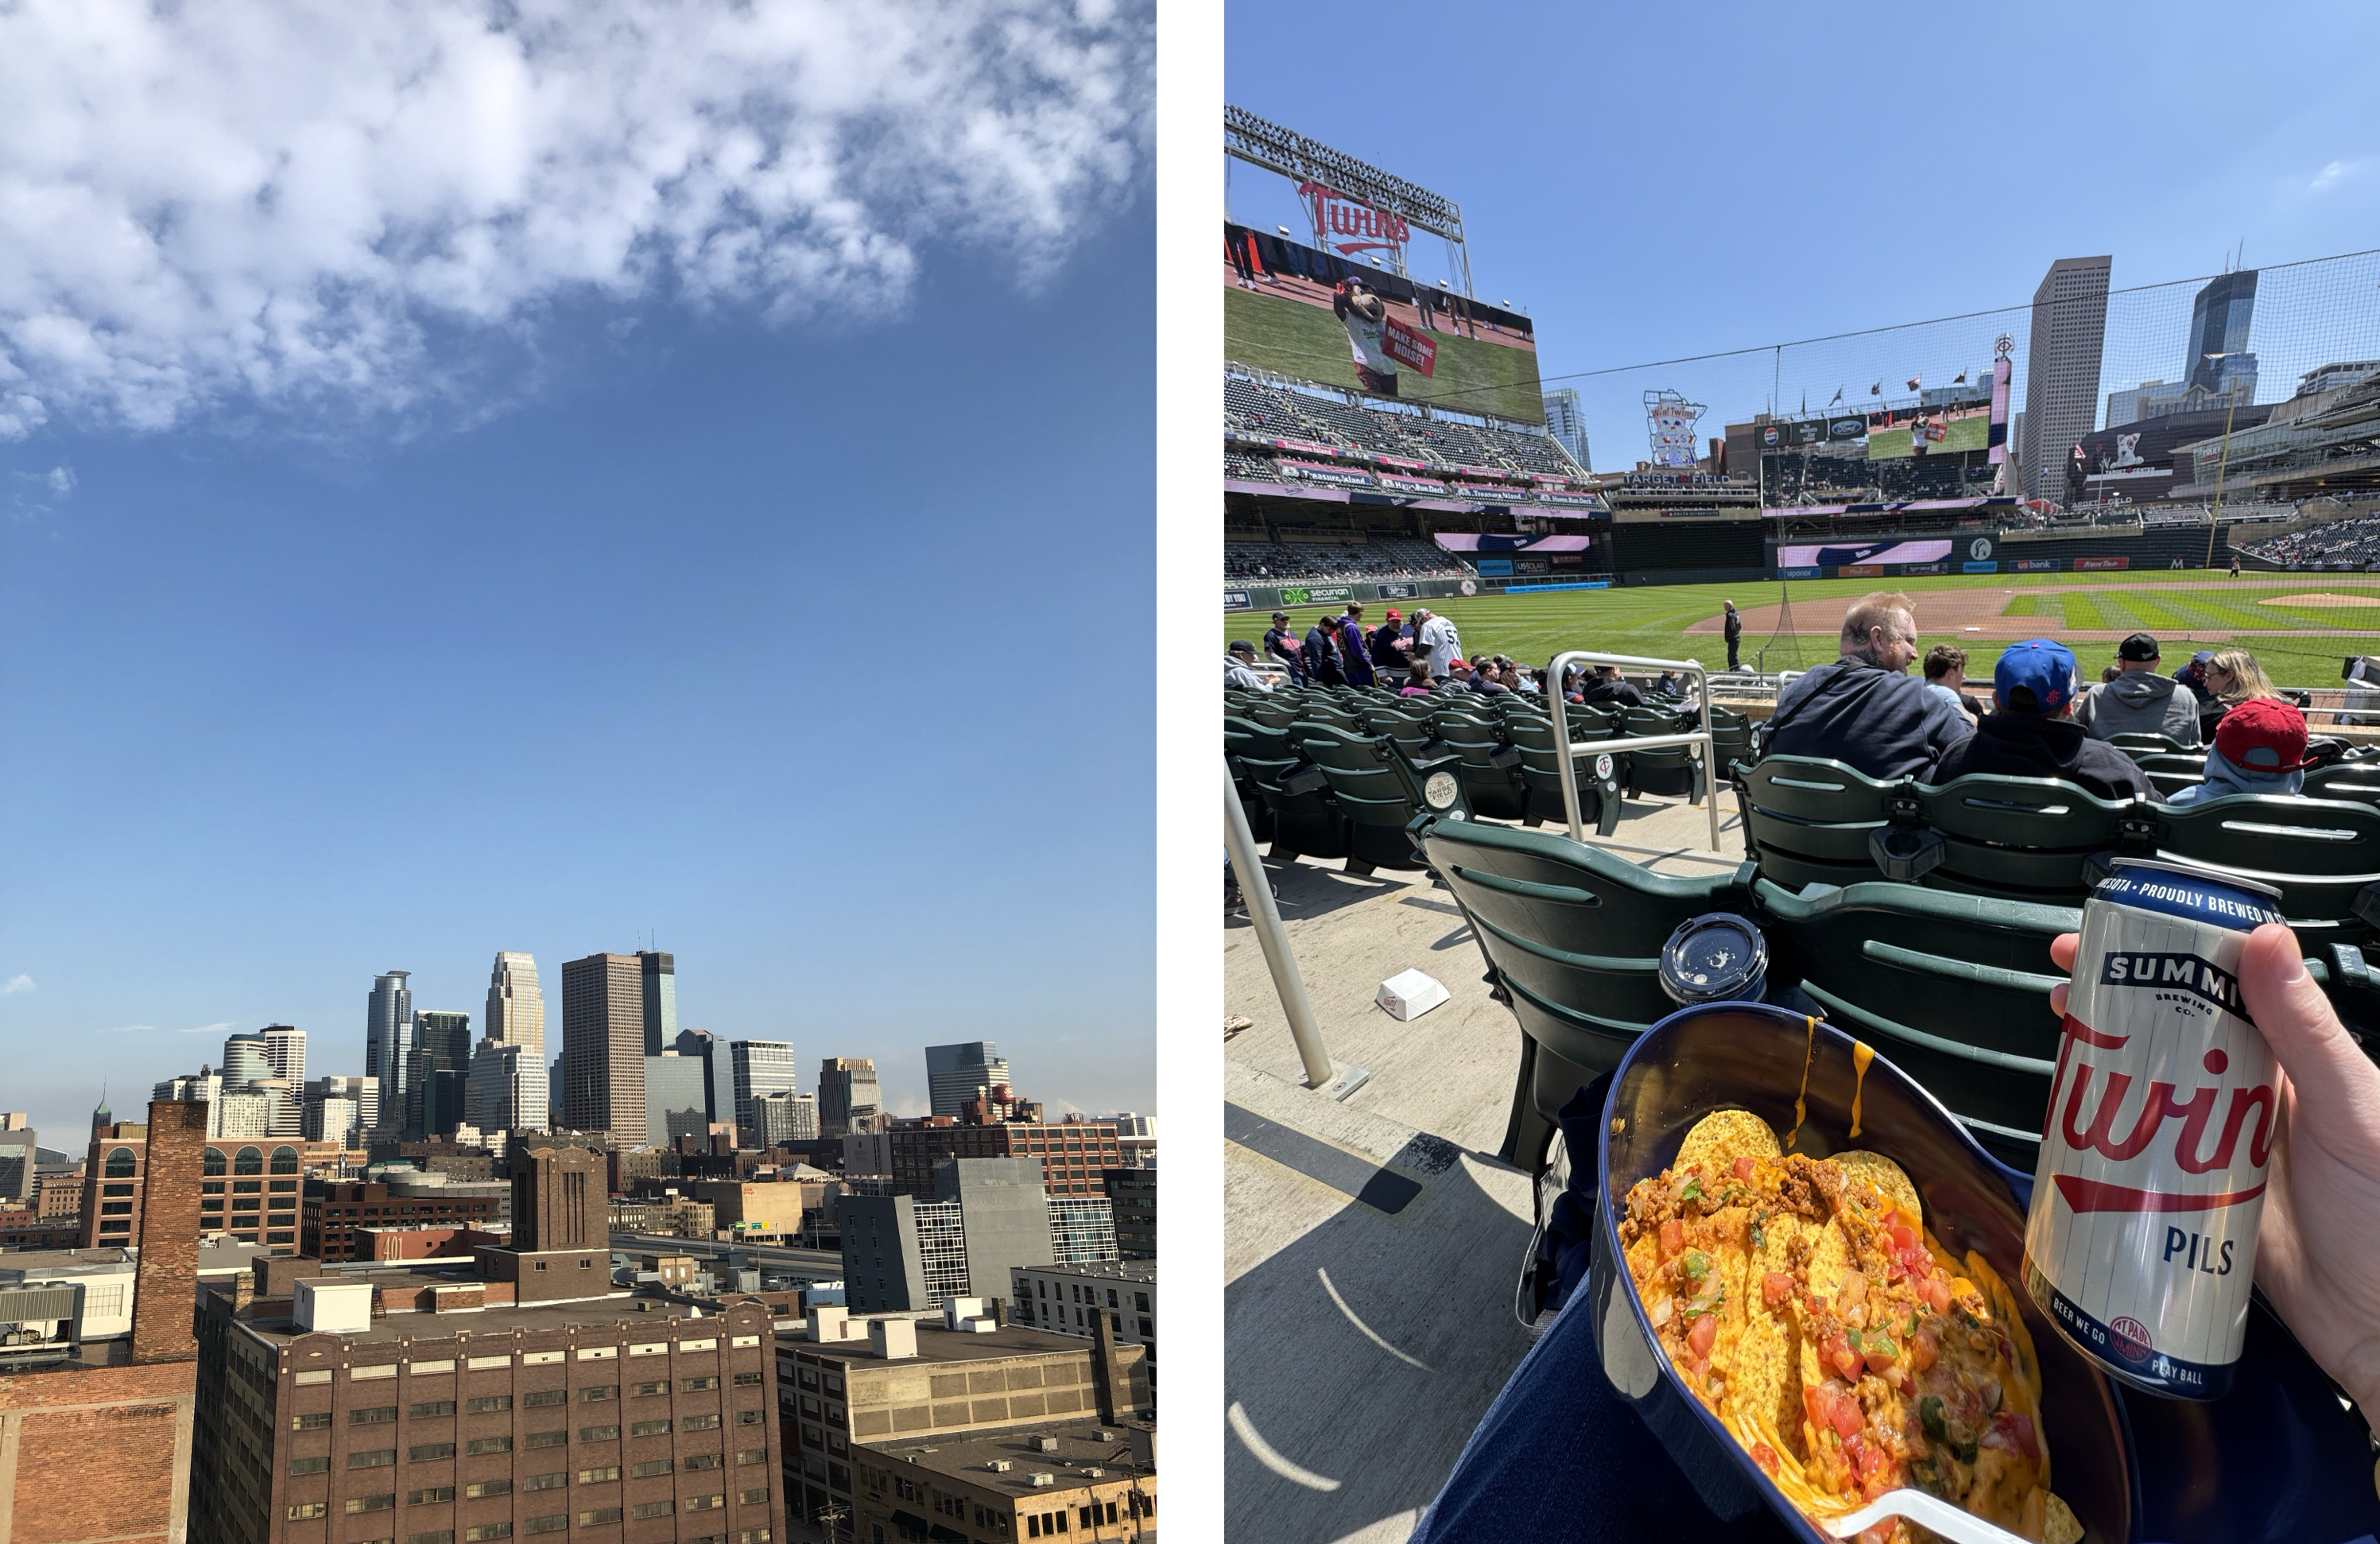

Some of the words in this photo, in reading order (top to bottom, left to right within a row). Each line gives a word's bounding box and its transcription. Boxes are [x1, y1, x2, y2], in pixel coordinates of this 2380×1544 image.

[1299, 181, 1410, 243] Twins
[1387, 326, 1411, 345] MAKE
[1411, 339, 1434, 358] SOME
[1394, 341, 1425, 367] NOISE!
[1837, 423, 1857, 433] Ford
[1284, 442, 1312, 452] Treasure
[1313, 445, 1332, 455] Island
[1625, 475, 1679, 484] TARGET
[1692, 475, 1731, 484] FIELD
[2029, 560, 2051, 568] bank
[1787, 569, 1812, 579] uponor
[1225, 594, 1234, 603] BY
[1233, 593, 1246, 603] YOU
[1310, 588, 1349, 597] securian
[1428, 783, 1455, 797] TARGET
[1432, 789, 1452, 800] FIELD
[2138, 883, 2203, 908] PROUDLY
[2208, 895, 2263, 923] BREWED
[2262, 909, 2275, 925] IN
[2109, 956, 2243, 1008] SUMMI
[2155, 993, 2213, 1016] BREWING
[2175, 1006, 2195, 1018] CO.
[383, 1235, 403, 1261] 401
[2162, 1226, 2235, 1276] PILS
[2052, 1297, 2074, 1323] BEER
[2076, 1317, 2090, 1335] WE
[2091, 1329, 2106, 1345] GO
[2152, 1359, 2178, 1379] PLAY
[2180, 1368, 2203, 1386] BALL
